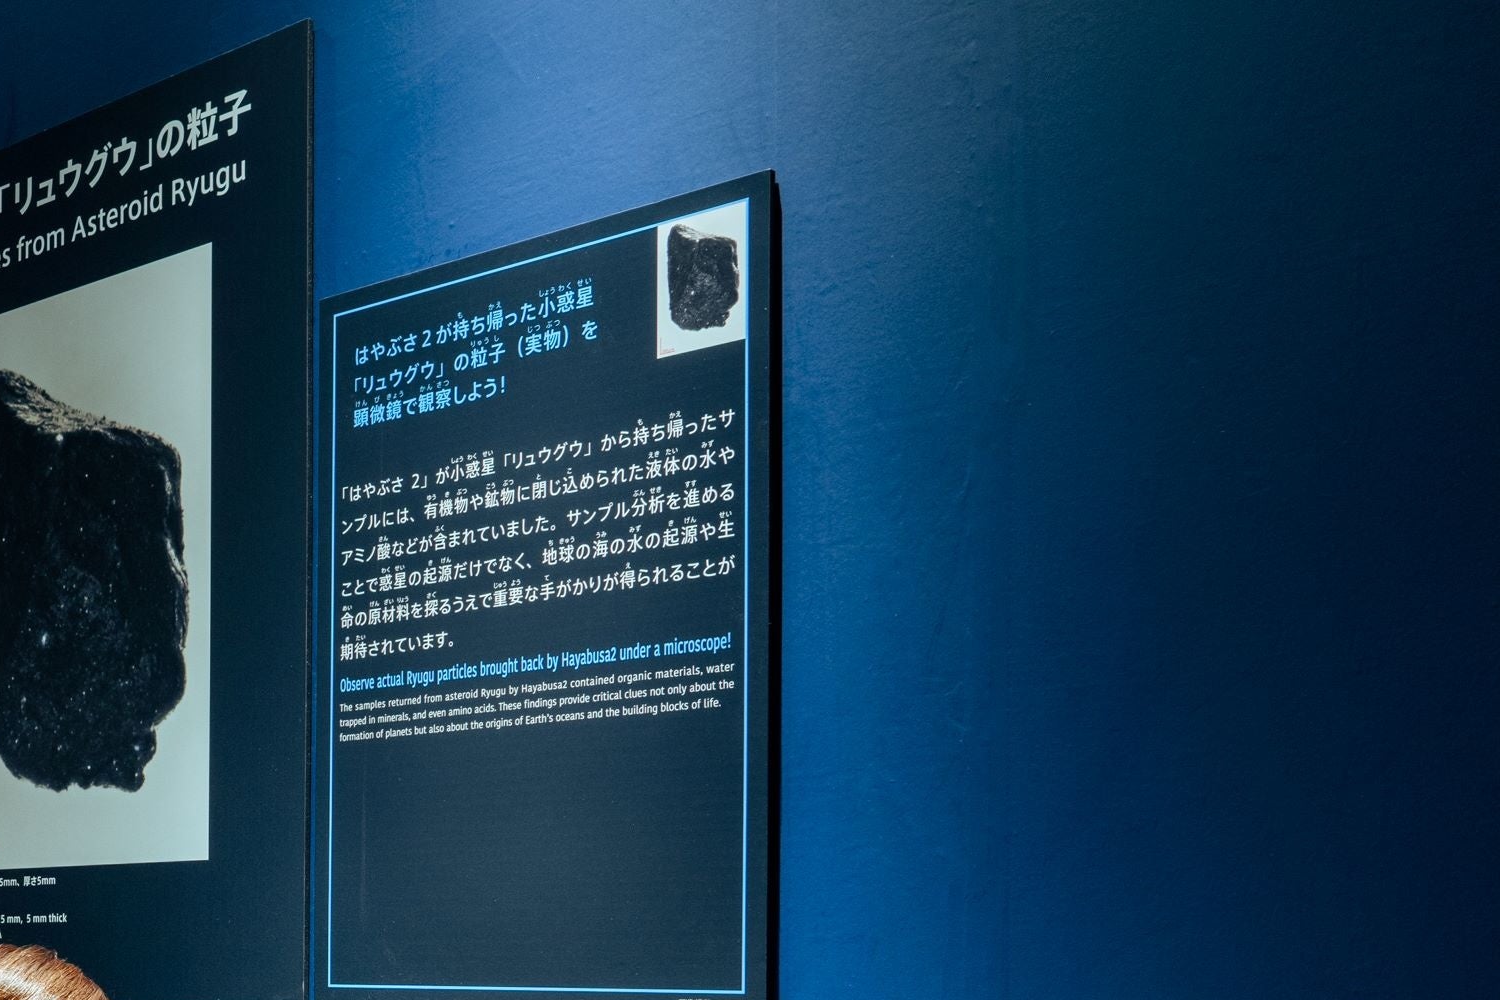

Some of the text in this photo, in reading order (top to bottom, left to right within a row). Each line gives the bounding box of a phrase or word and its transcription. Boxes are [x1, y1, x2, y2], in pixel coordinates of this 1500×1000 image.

[16, 227, 64, 262] from
[71, 183, 162, 242] Asteroid
[171, 159, 246, 207] Ryugu
[354, 286, 594, 366] はやぶさ2が持ち帰った小惑星
[354, 320, 598, 393] 「リュウグウ」の粒子（実物）を
[353, 375, 506, 428] 顕微鏡で観察しよう！
[341, 446, 735, 535] ンプルには、有機物や鉱物に閉じ込められた液体の水や
[341, 483, 735, 566] アミノ酸などが含まれていました。サンプル分析を進める
[341, 519, 735, 597] ことで惑星の起源だけでなく、地球の海の水の起源や生
[340, 554, 736, 629] 命の原材料を探るうえで重要な手がかりが得られることが
[340, 631, 454, 661] 期待されています。
[340, 631, 730, 692] Observe actual Ryugu particles brought back by Hayabusa2 under a microscope!
[339, 663, 734, 712] The samples returned from asteroid Ryugu by Hayabusa2 contained organic materials, water
[339, 679, 734, 728] trapped in minerals, and even amino acids. These findings provide critical clues not only about the
[339, 730, 374, 742] formation
[375, 728, 384, 739] of
[385, 727, 412, 740] planets
[414, 725, 427, 735] but
[428, 723, 444, 734] also
[446, 721, 468, 732] about
[470, 719, 484, 730] the
[485, 717, 512, 730] origins
[514, 715, 524, 726] of
[555, 711, 584, 722] oceans
[586, 707, 603, 719] and
[604, 707, 620, 717] the
[622, 703, 658, 716] building
[660, 700, 688, 712] blocks
[691, 698, 701, 709] of
[703, 697, 721, 708] life.
[6, 915, 23, 924] mm,
[32, 915, 47, 923] mm
[48, 912, 67, 923] thick
